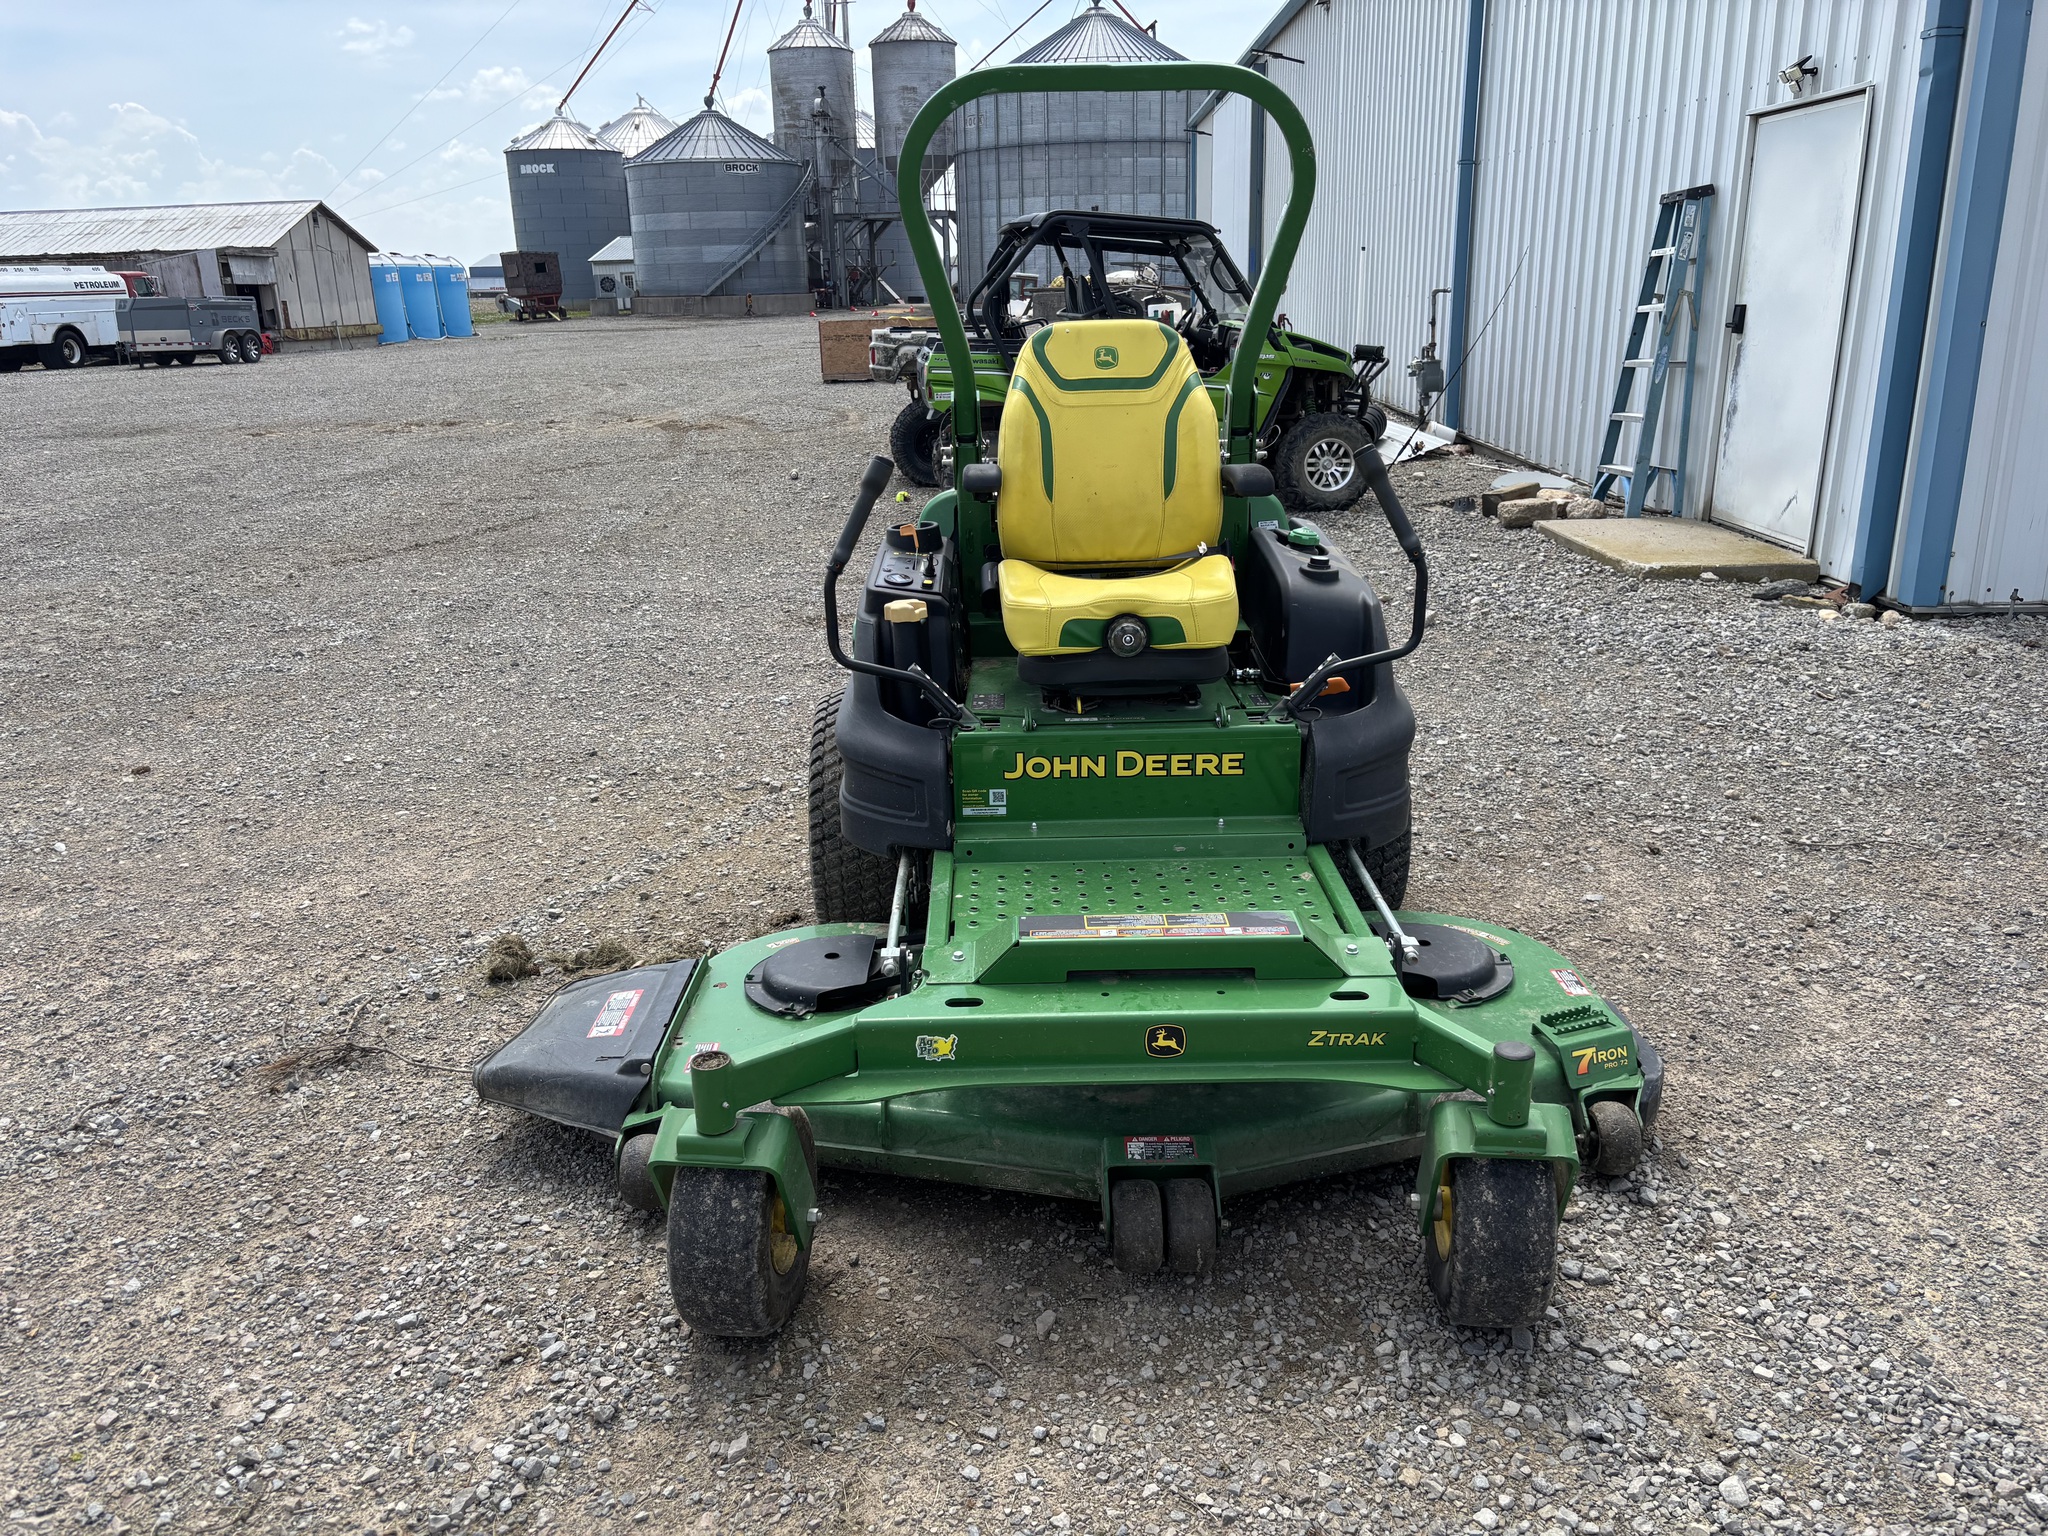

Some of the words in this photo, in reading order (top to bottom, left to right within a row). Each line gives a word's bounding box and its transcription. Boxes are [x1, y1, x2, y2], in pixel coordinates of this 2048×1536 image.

[520, 163, 555, 174] BROCK
[725, 163, 759, 172] BROCK
[74, 281, 120, 289] PETROLEUM
[221, 315, 251, 323] BECK'S
[920, 1046, 938, 1056] Pro
[1604, 1061, 1618, 1069] PRO
